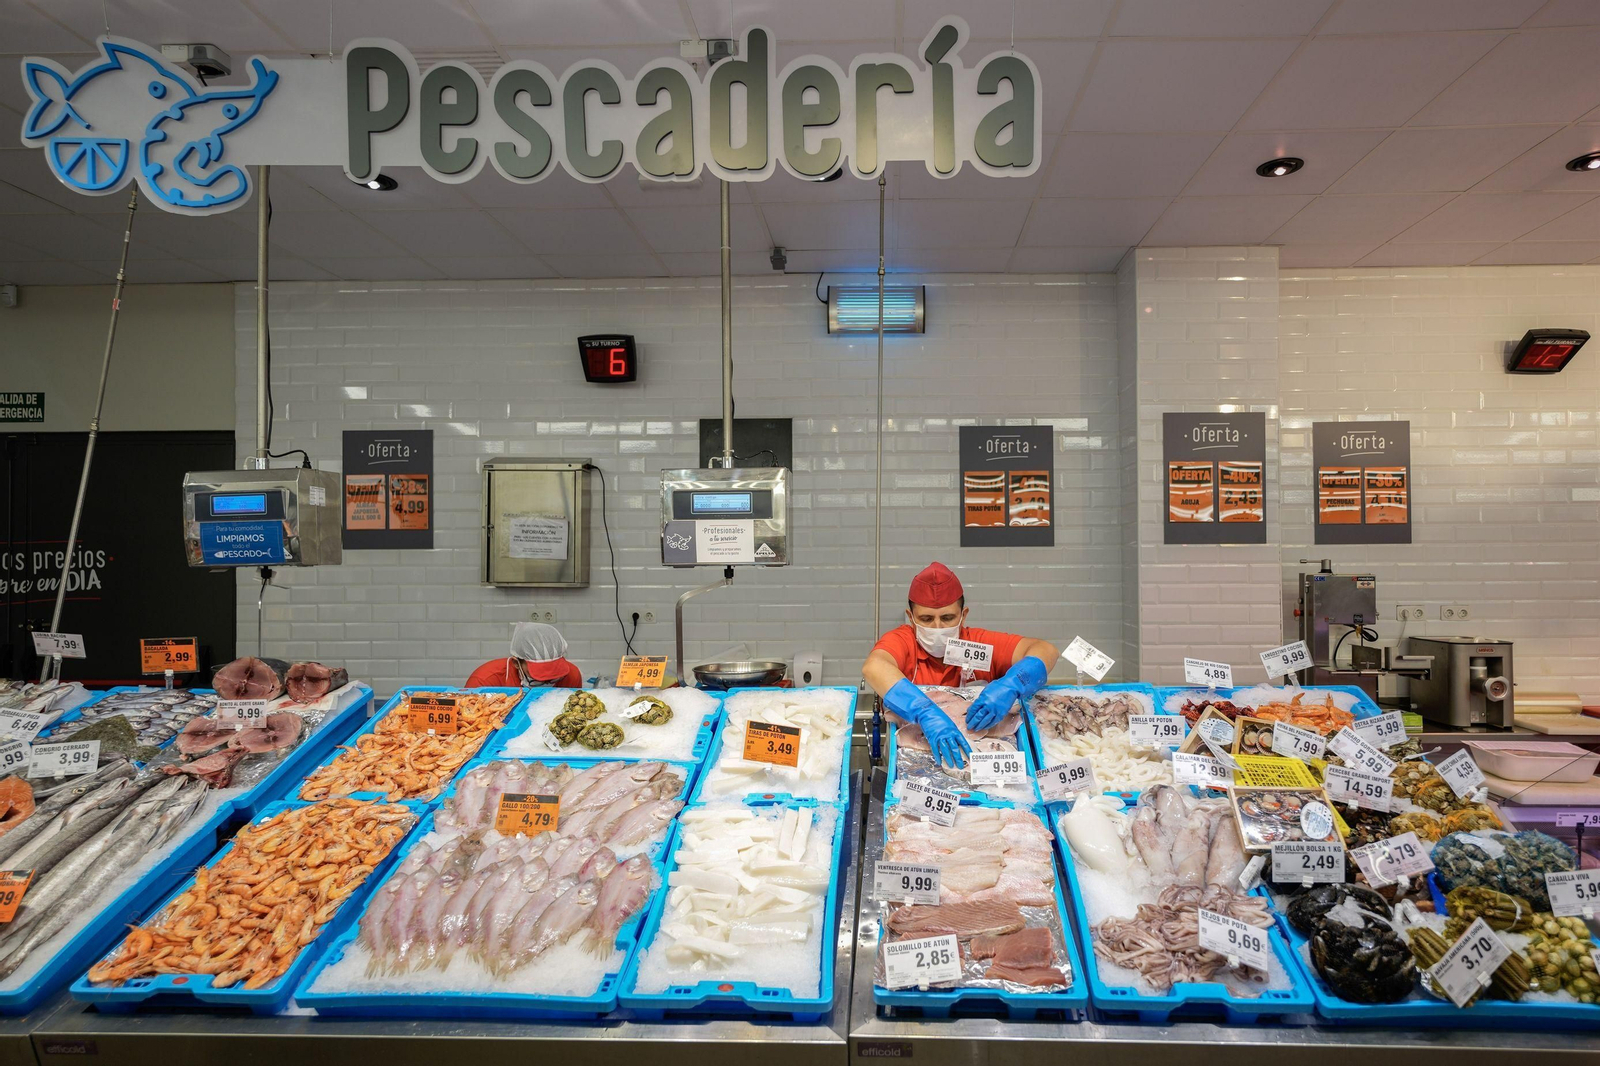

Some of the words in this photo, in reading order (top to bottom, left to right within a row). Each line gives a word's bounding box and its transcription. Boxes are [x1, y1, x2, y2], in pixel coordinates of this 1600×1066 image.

[347, 25, 1034, 178] Pescadería
[610, 348, 625, 375] 6
[1533, 345, 1574, 366] 12
[26, 394, 37, 405] DE
[1192, 427, 1240, 443] Oferta
[1341, 434, 1386, 450] Oferta
[368, 443, 410, 457] Oferta
[986, 439, 1030, 453] Oferta
[1172, 470, 1211, 481] OFERTA
[216, 534, 265, 543] LIMPIAMOS
[223, 550, 262, 558] PESCADO
[66, 569, 102, 592] DIA
[54, 640, 76, 651] 7,99
[165, 652, 190, 664] 2,99
[964, 648, 986, 662] 6,99
[1282, 650, 1305, 665] 9,99
[637, 668, 660, 680] 4,99
[1205, 669, 1226, 680] 4,89
[237, 708, 260, 721] 9,99
[428, 713, 451, 725] 6,99
[11, 719, 38, 731] 6,49
[1152, 725, 1178, 739] 7,99
[1376, 721, 1399, 737] 5,99
[749, 729, 763, 737] TIRAS
[63, 743, 90, 751] CERRADO
[767, 740, 793, 756] 3,49
[1294, 737, 1318, 755] 7,99
[59, 751, 90, 766] 3,99
[1355, 749, 1383, 774] 5,99
[993, 761, 1019, 775] 9,99
[1036, 768, 1050, 777] SEPIA
[1050, 763, 1068, 773] LIMPIA
[1058, 766, 1085, 784] 9,99
[1456, 761, 1474, 779] 4,59
[1329, 767, 1350, 777] PERCEBE
[1351, 771, 1371, 780] GRANDE
[1371, 776, 1391, 785] IMPORT
[907, 781, 923, 791] FILETE
[931, 789, 958, 801] GALLINETA
[1344, 779, 1383, 798] 14,59
[925, 796, 953, 814] 8,95
[522, 812, 551, 829] 4,79
[1275, 845, 1306, 853] MEJILLÓN
[1306, 845, 1326, 853] BOLSA
[1302, 855, 1335, 872] 2,49
[902, 876, 932, 893] 9,99
[1576, 873, 1590, 881] VIVA
[1201, 910, 1220, 922] REJOS
[1231, 921, 1248, 932] POTA
[887, 942, 922, 953] SOLOMILLO
[923, 941, 931, 949] DE
[933, 938, 950, 948] ATÚN
[1228, 929, 1261, 952] 9,69
[915, 949, 951, 970] 2,85
[1434, 958, 1450, 977] NAVAJA
[1449, 936, 1471, 961] AMERICANA
[1461, 936, 1492, 971] 3,70
[861, 1047, 901, 1058] efficold
